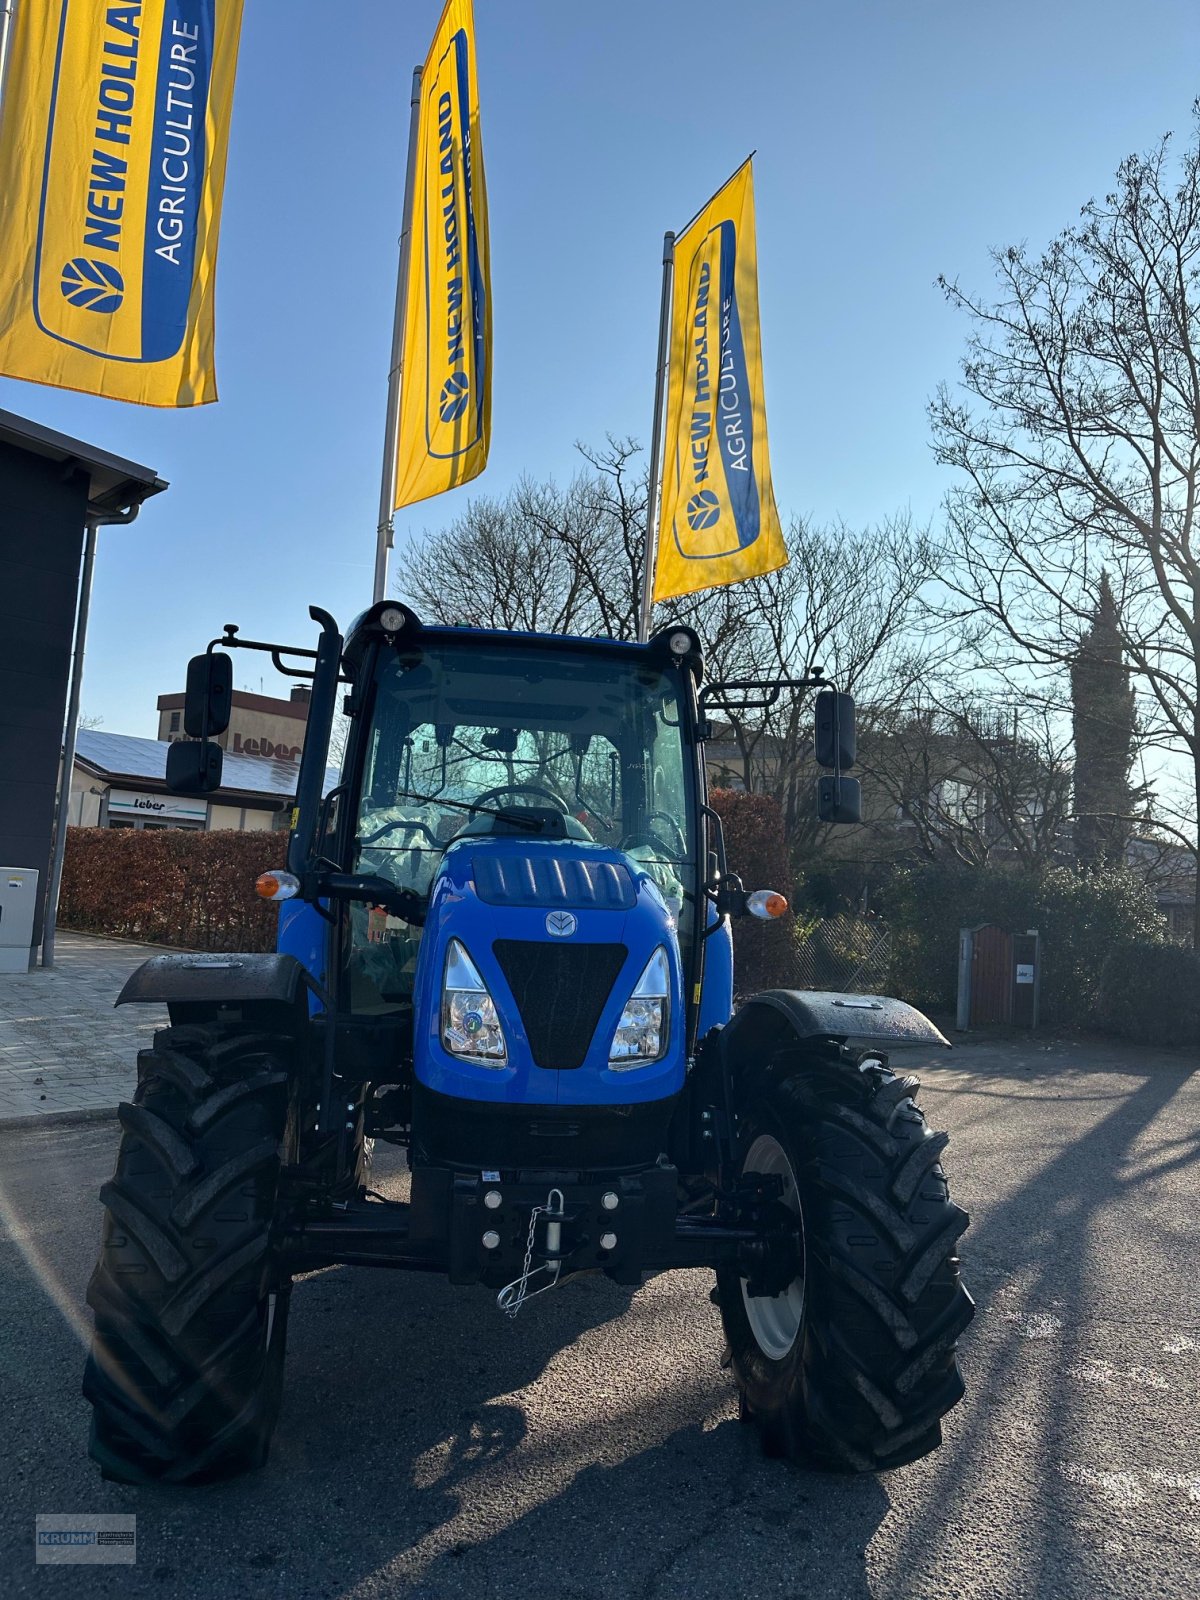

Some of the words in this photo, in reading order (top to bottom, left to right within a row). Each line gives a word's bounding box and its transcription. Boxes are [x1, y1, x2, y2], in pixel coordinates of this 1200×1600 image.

[95, 0, 142, 145] HOLLA
[155, 19, 199, 266] AGRICULTURE
[439, 91, 460, 272] HOLLAND
[83, 149, 128, 252] NEW
[447, 276, 464, 366] NEW
[720, 295, 748, 471] AGRICULTURE
[691, 412, 711, 484] NEW
[233, 733, 302, 761] Leber
[134, 799, 165, 810] Leber
